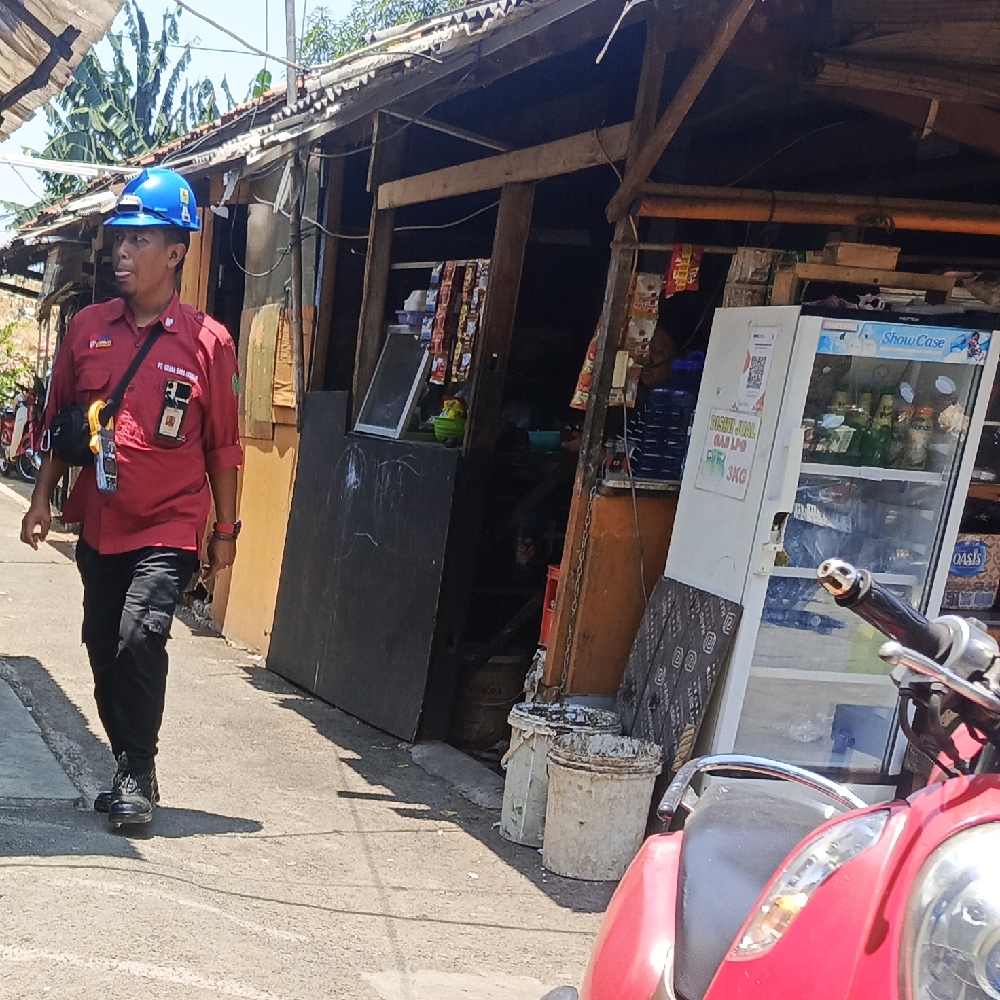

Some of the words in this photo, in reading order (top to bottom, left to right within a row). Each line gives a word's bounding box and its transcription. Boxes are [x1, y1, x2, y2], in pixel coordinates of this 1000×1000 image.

[710, 415, 736, 434] DISINI
[735, 420, 756, 439] JUAL
[726, 465, 747, 485] 3KG
[952, 548, 982, 566] OASIS
